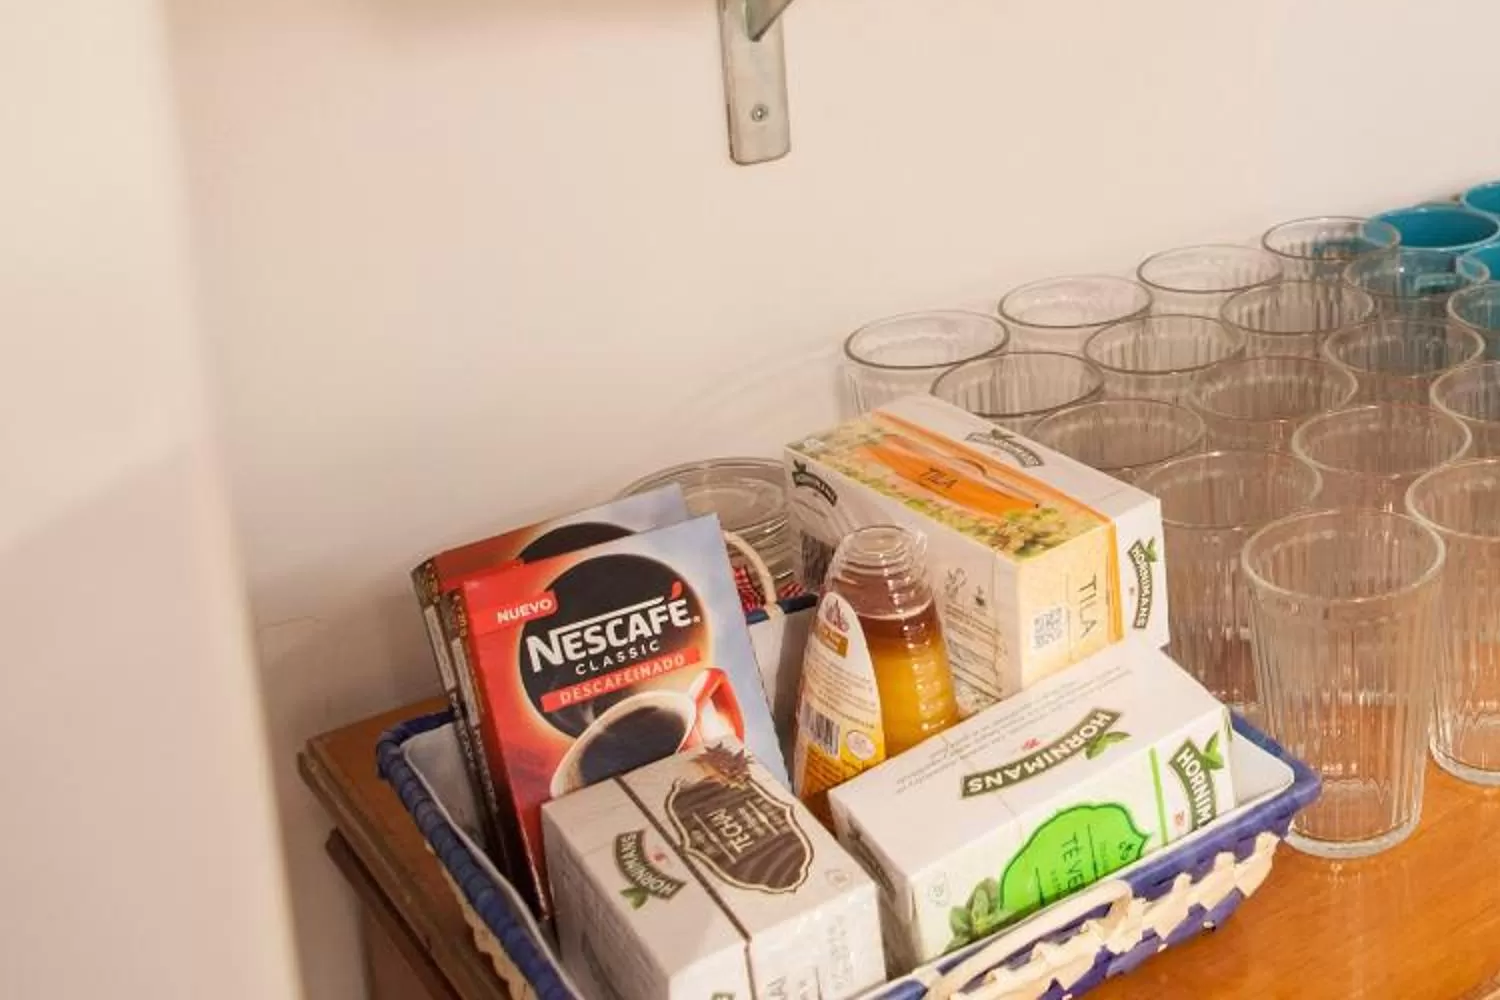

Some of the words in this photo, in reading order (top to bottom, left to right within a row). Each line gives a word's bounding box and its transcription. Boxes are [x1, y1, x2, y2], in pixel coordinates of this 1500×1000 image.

[496, 598, 552, 624] NUEVO
[526, 581, 692, 673] NESCAFÉ
[1077, 574, 1098, 638] TILA
[559, 654, 685, 705] DESCAFEINADO
[575, 640, 661, 676] CLASSIC
[967, 711, 1111, 793] HORNIMANS
[1176, 747, 1211, 825] HORNIM
